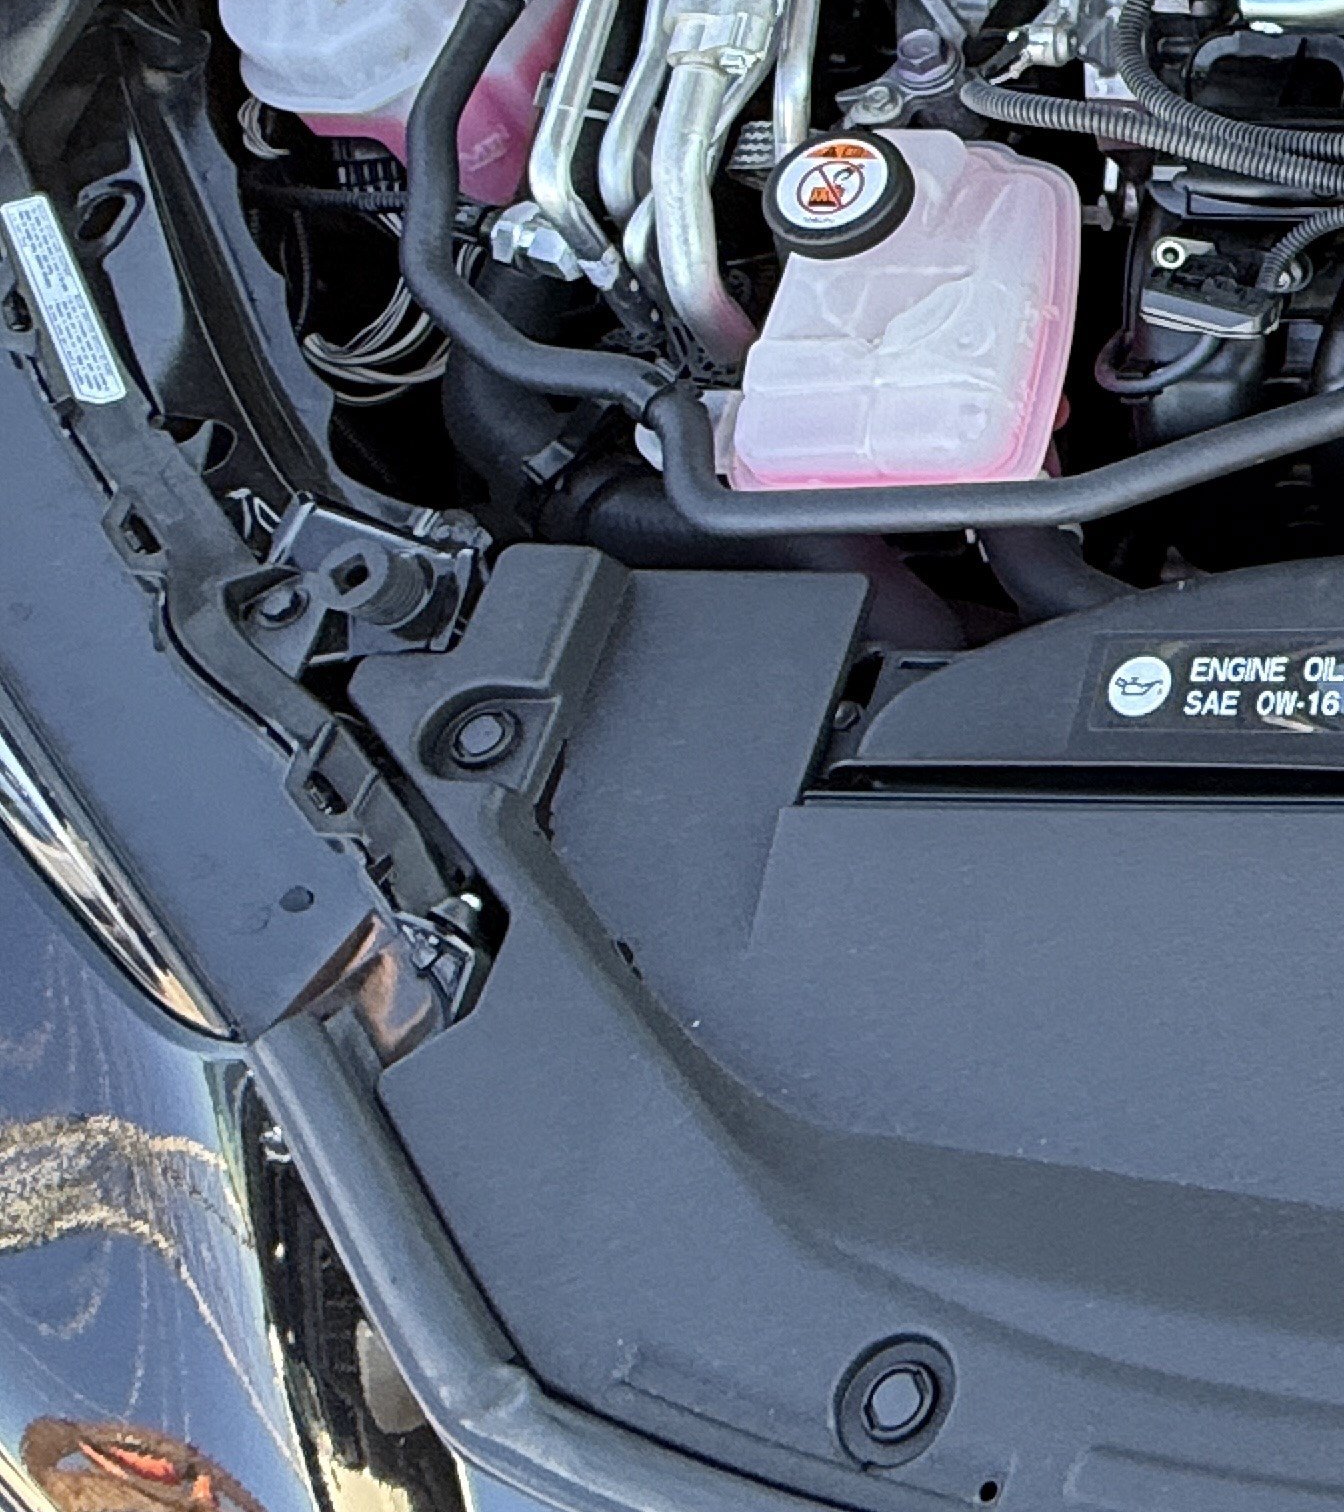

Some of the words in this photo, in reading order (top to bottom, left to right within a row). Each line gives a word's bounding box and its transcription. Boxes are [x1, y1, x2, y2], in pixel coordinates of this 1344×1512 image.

[1189, 656, 1289, 682] ENGINE
[1183, 690, 1240, 716] SAE
[1256, 690, 1342, 716] 0W-16
